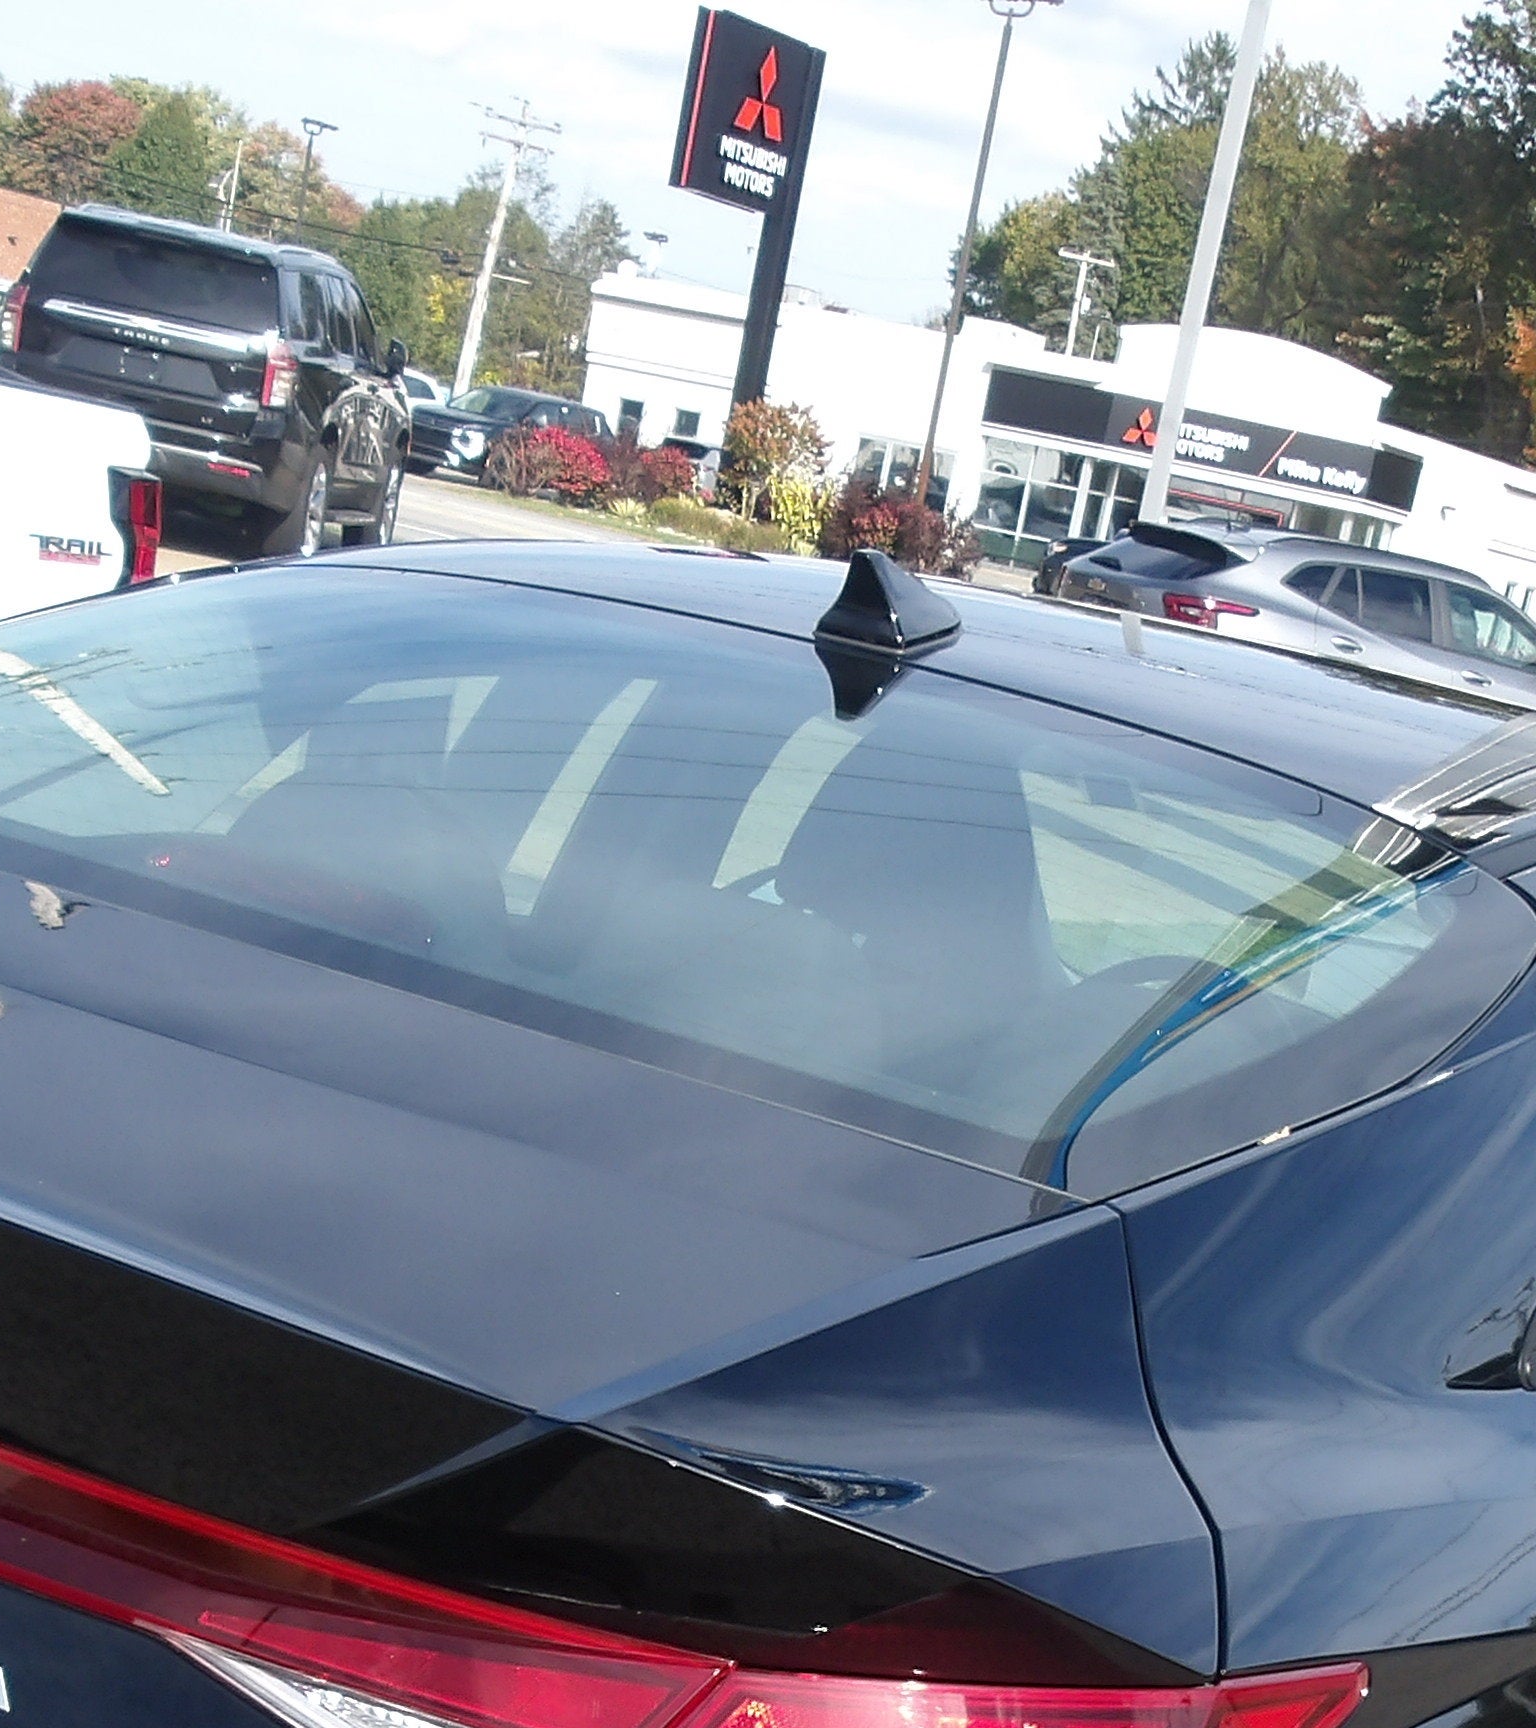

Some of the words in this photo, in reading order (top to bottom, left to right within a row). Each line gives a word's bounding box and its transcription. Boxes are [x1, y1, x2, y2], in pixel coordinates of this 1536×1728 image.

[720, 134, 787, 177] MITSUBISHI
[724, 161, 775, 197] MOTORS
[1175, 439, 1225, 462] OTORS
[1178, 422, 1249, 451] ITSUBISHI
[29, 533, 112, 556] TRAIL
